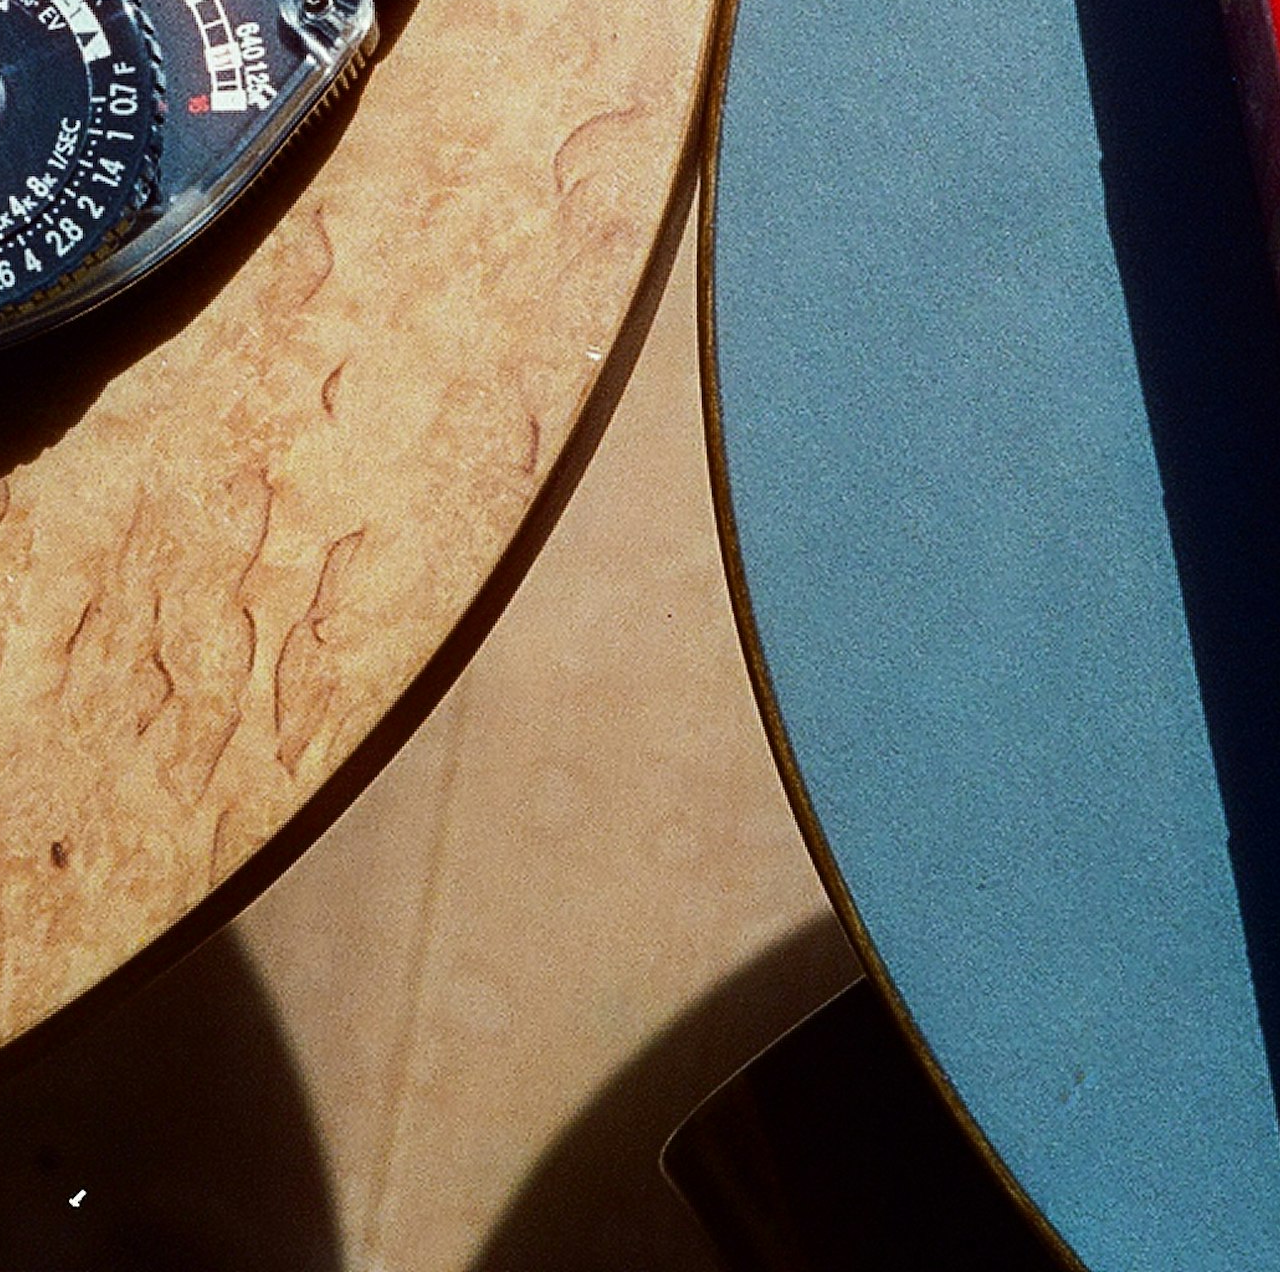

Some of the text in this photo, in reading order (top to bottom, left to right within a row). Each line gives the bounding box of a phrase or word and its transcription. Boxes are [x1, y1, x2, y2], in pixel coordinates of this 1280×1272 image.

[37, 7, 67, 31] EV
[235, 21, 265, 62] 640
[112, 61, 137, 76] F
[47, 117, 81, 170] 1/SEC
[106, 130, 135, 141] 1
[76, 195, 105, 219] 2
[23, 247, 42, 272] 4
